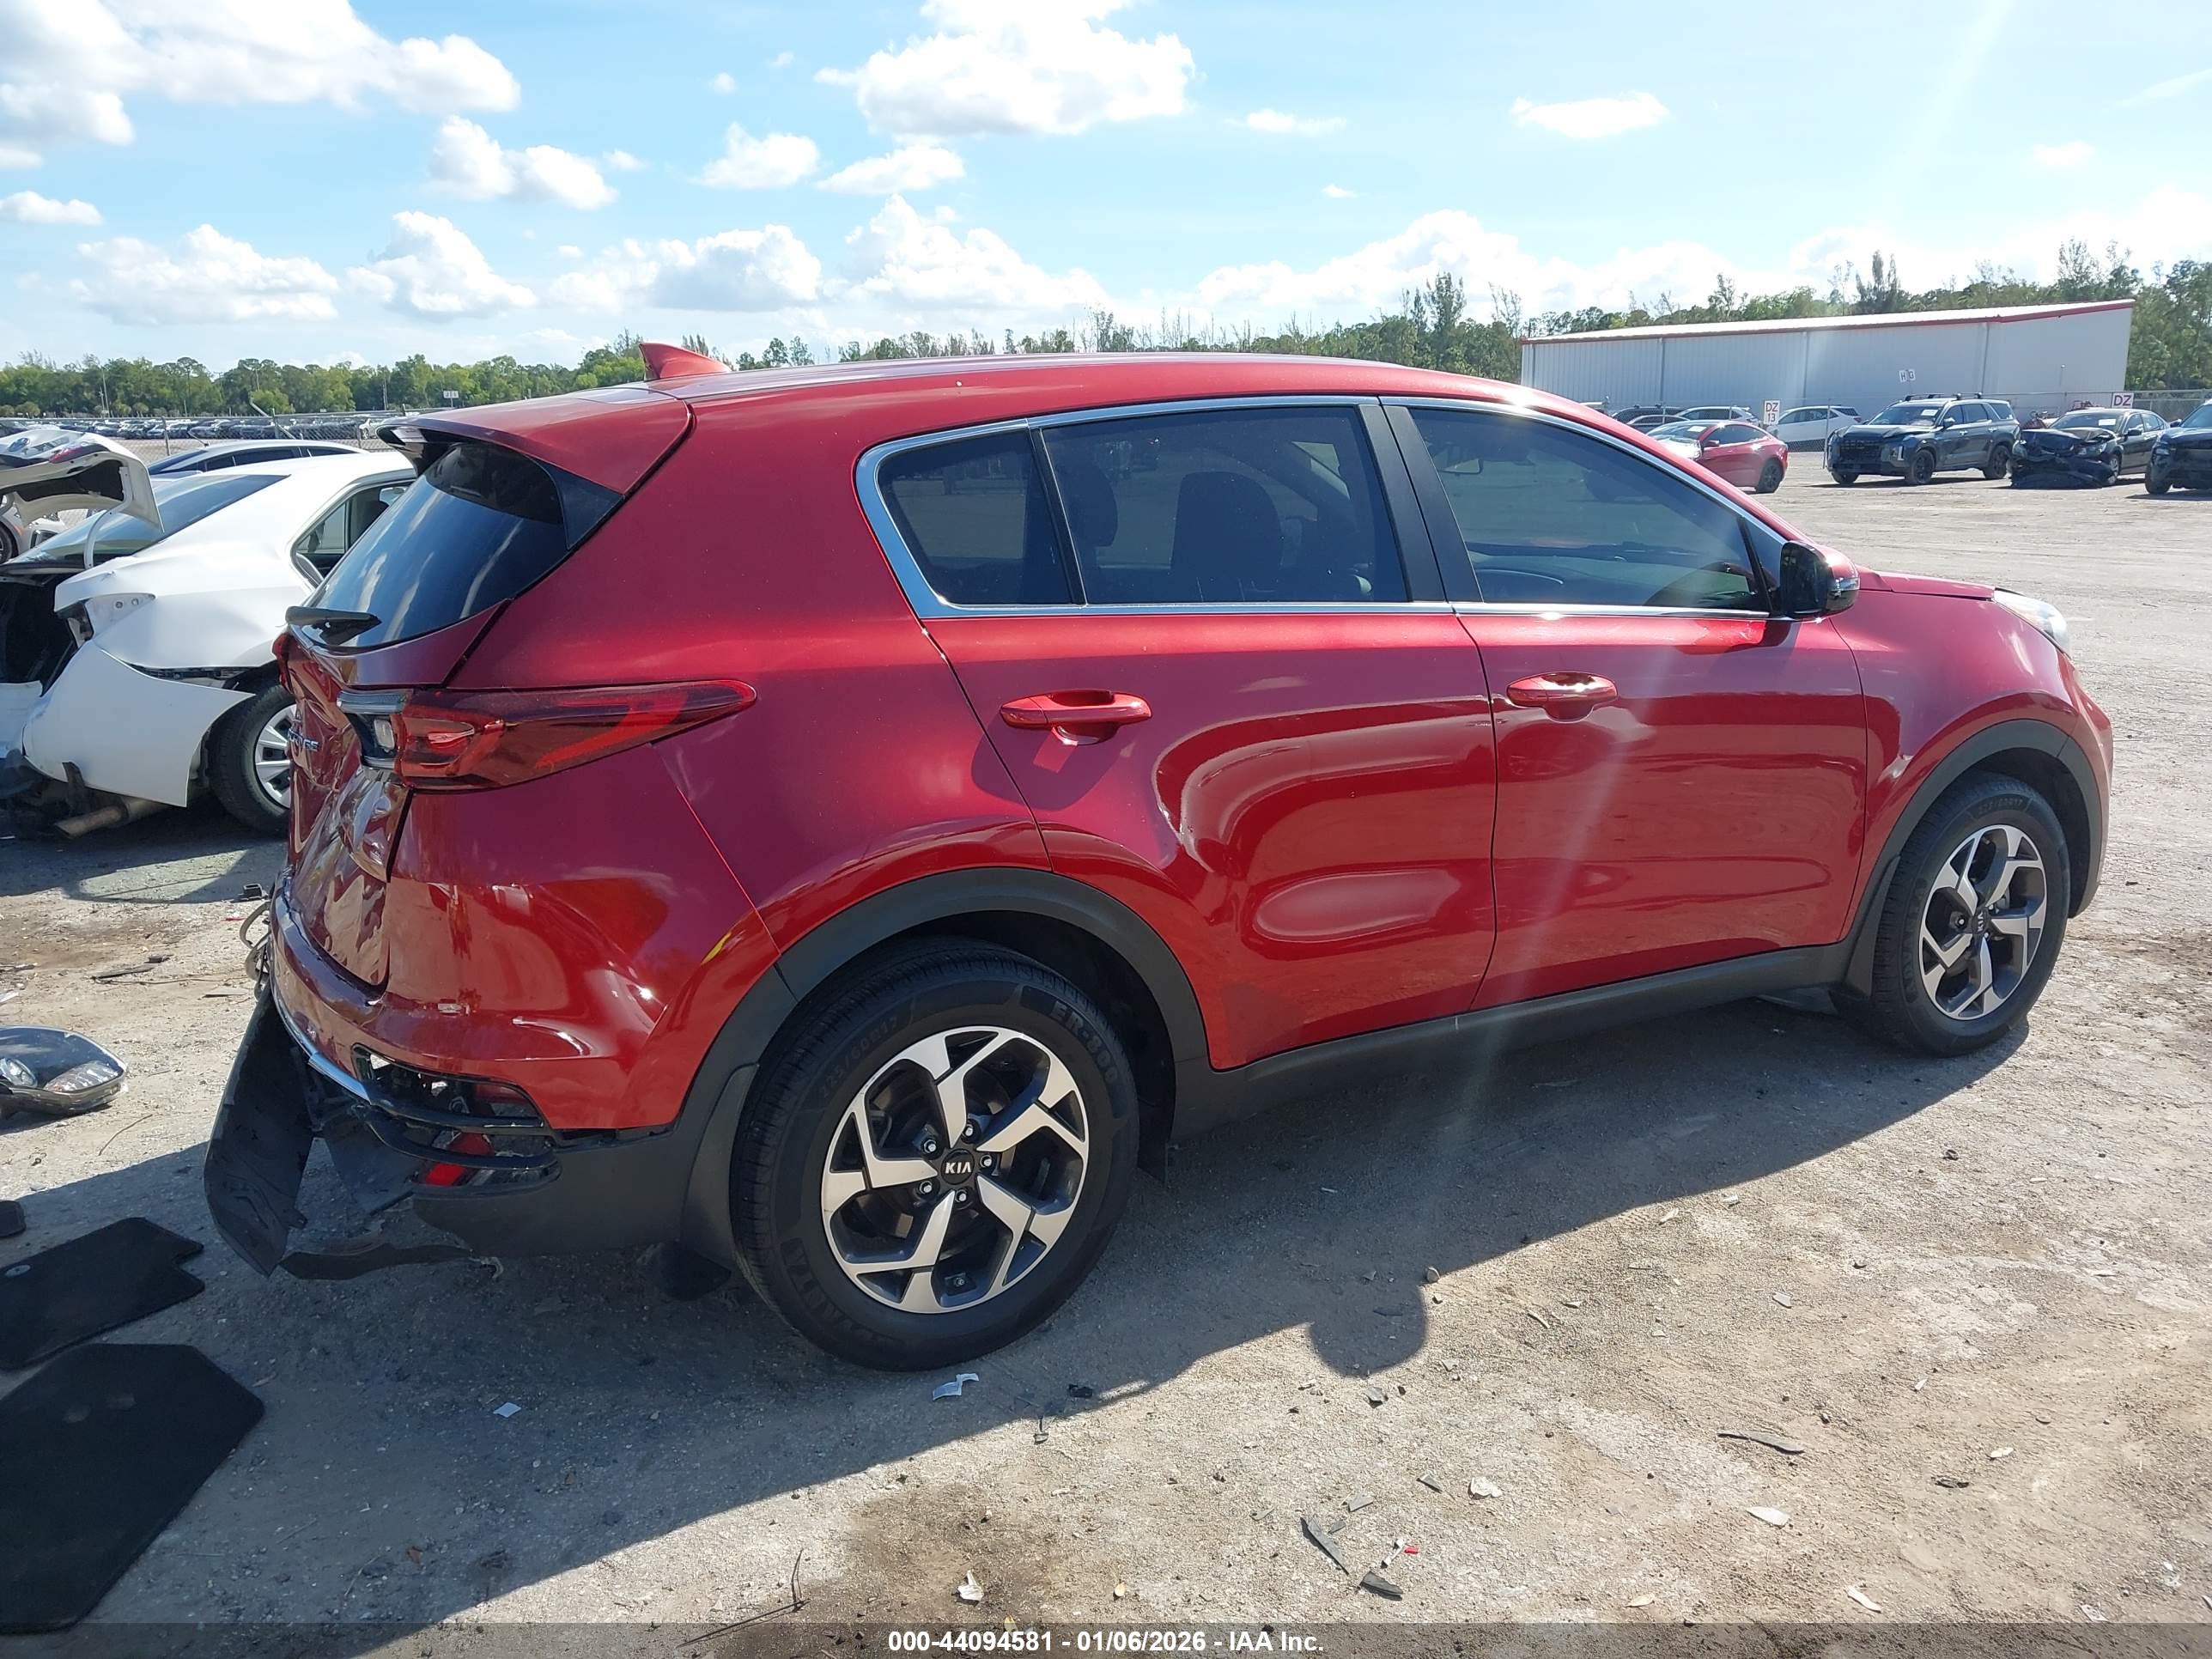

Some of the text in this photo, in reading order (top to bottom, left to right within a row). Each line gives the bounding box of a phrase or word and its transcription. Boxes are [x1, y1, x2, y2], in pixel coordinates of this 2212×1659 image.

[2113, 394, 2132, 406] DZ
[1765, 402, 1778, 412] DZ
[1767, 412, 1776, 422] 13
[945, 1161, 972, 1174] KIA
